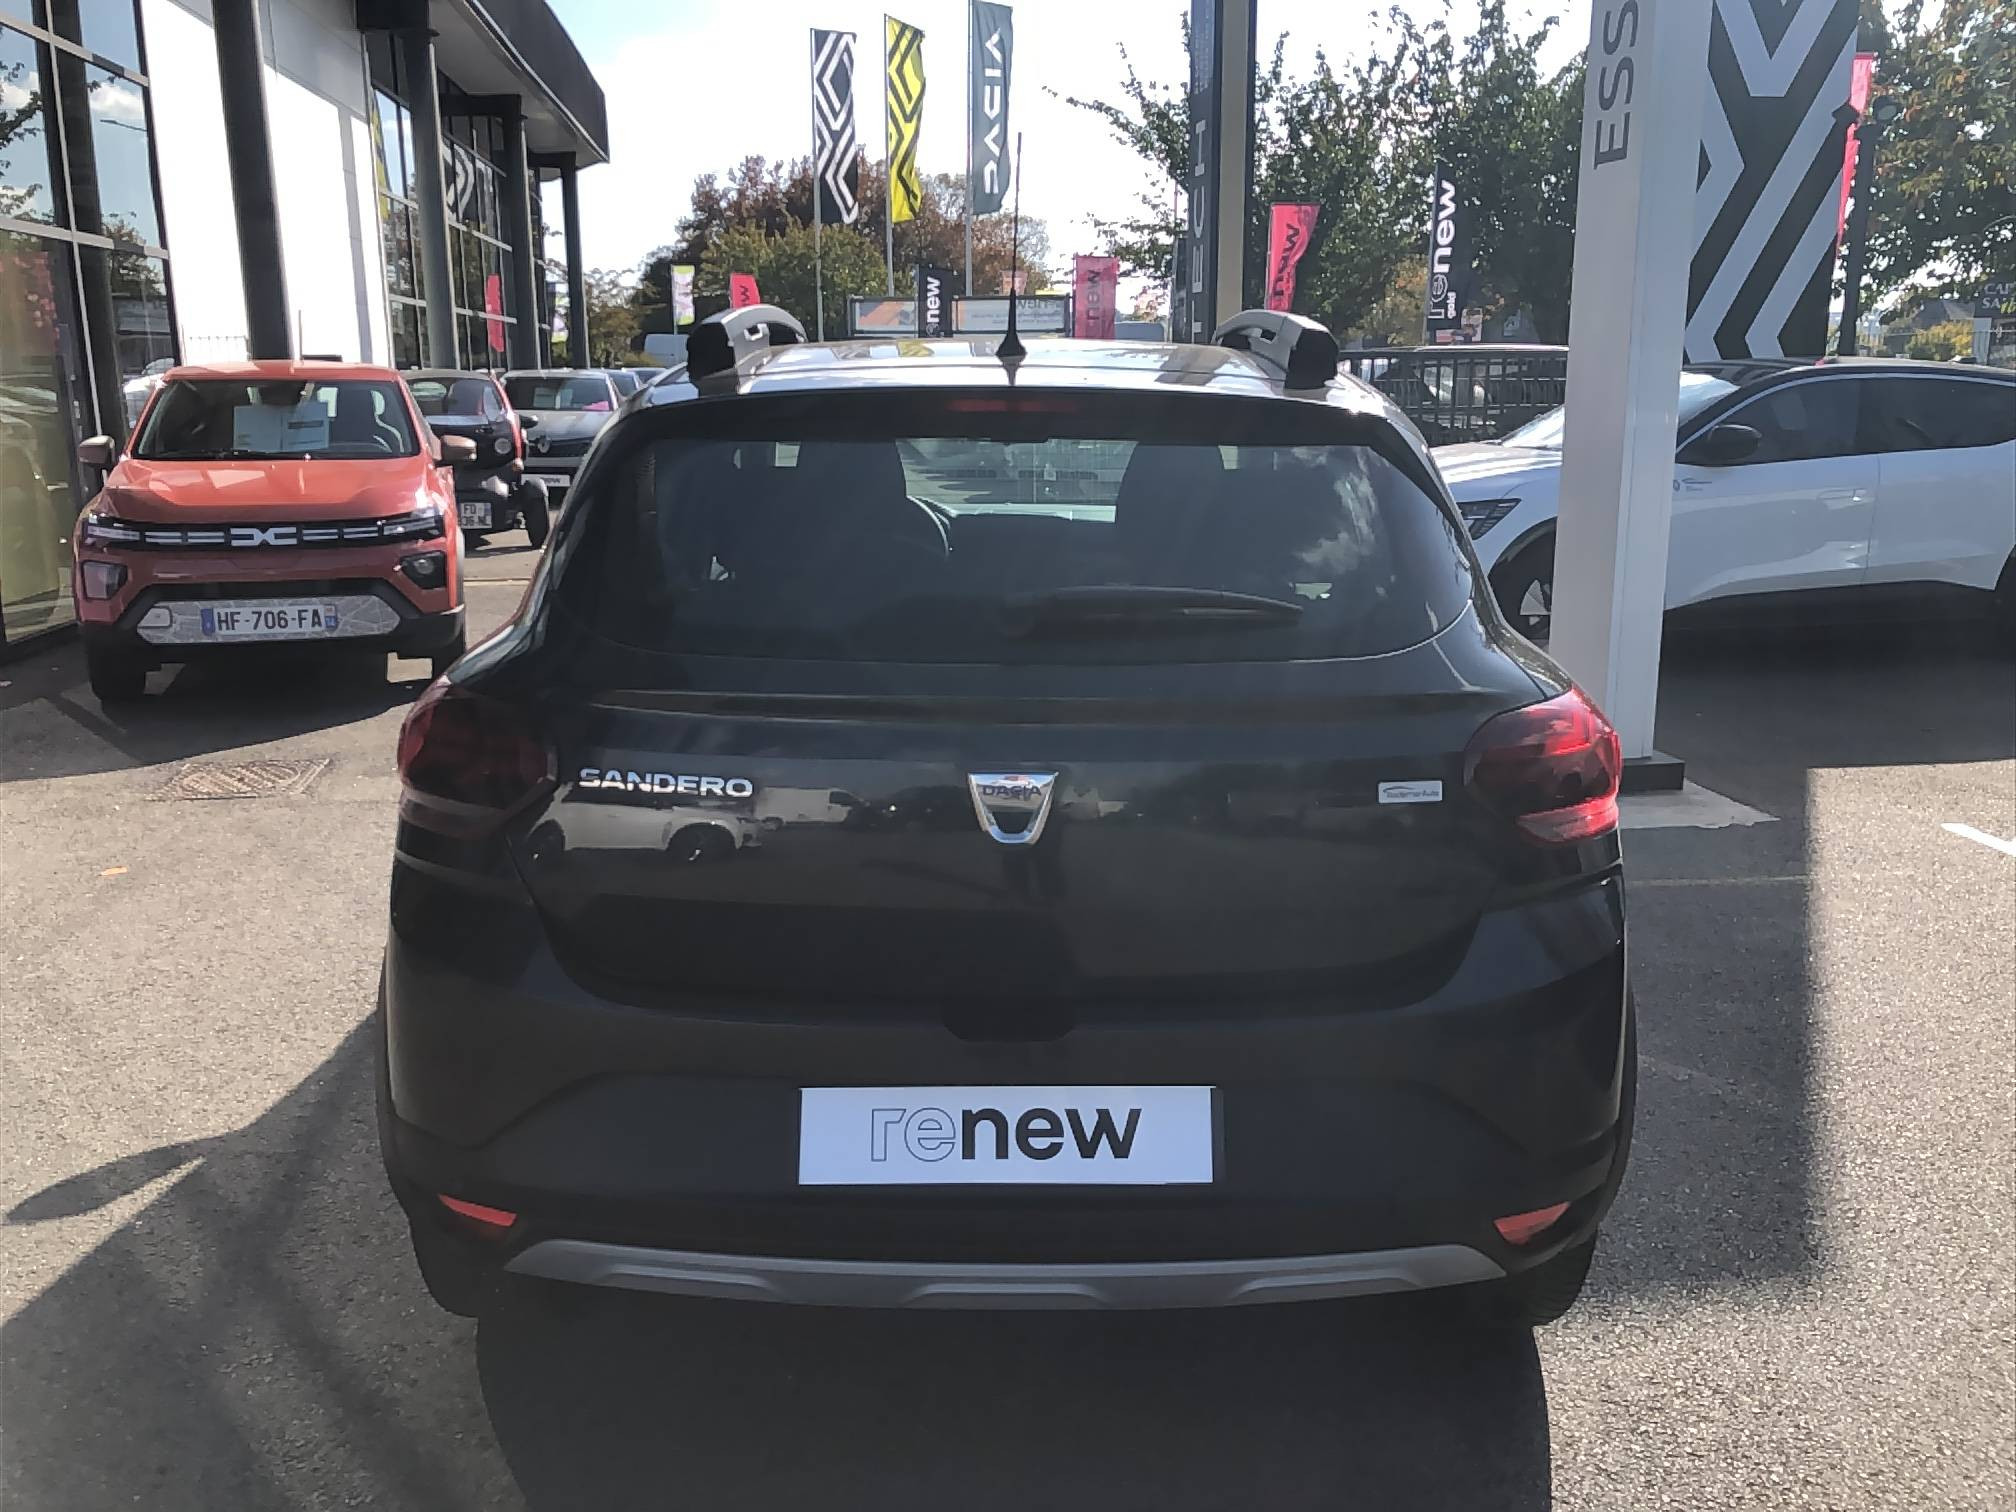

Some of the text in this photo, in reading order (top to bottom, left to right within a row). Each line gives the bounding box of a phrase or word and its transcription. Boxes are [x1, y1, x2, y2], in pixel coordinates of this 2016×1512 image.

[1427, 179, 1456, 319] renew
[217, 609, 322, 631] HF-706-FA
[579, 768, 753, 797] SANDERO
[982, 784, 1041, 798] DACIA
[871, 1107, 1142, 1162] renew
